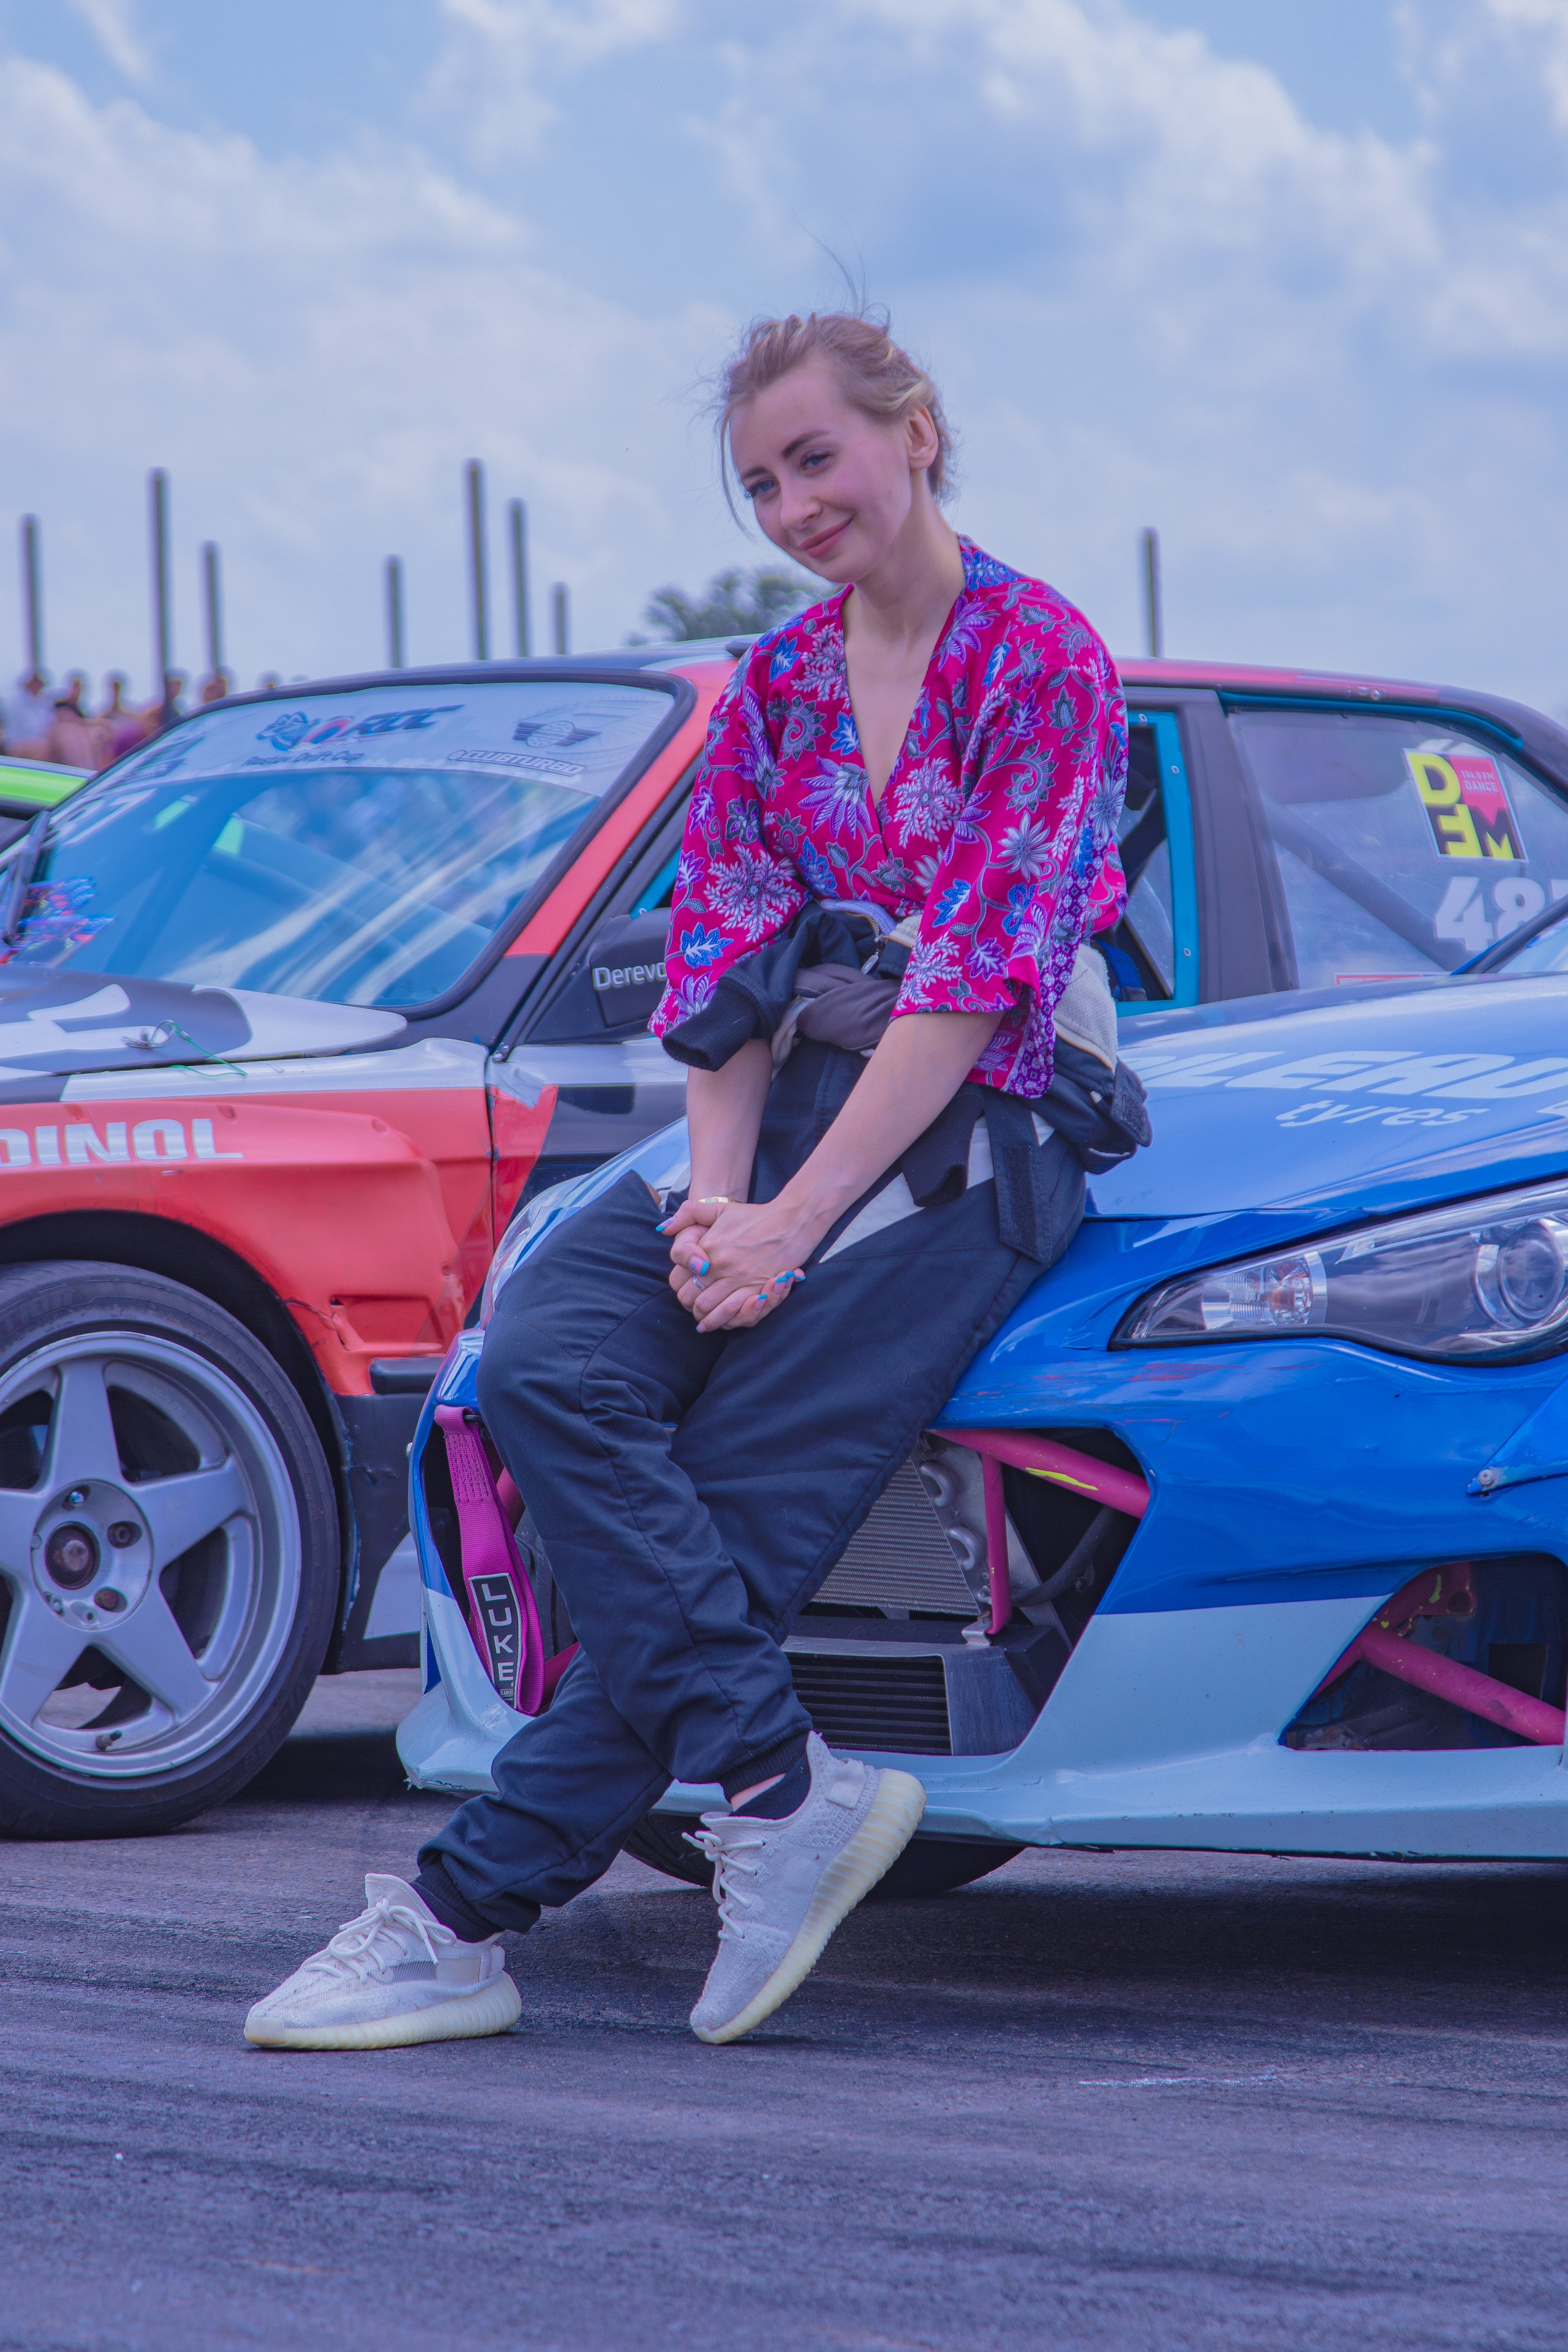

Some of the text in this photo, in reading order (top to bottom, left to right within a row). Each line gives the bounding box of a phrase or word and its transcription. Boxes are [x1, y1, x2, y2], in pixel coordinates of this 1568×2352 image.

[292, 750, 333, 763] Drift
[331, 750, 366, 764] Cup
[461, 750, 586, 775] CLUBTURBO
[1464, 780, 1499, 792] DANCE
[1436, 876, 1568, 951] 48
[1275, 1099, 1490, 1127] tyres
[481, 1583, 513, 1681] LUKE
